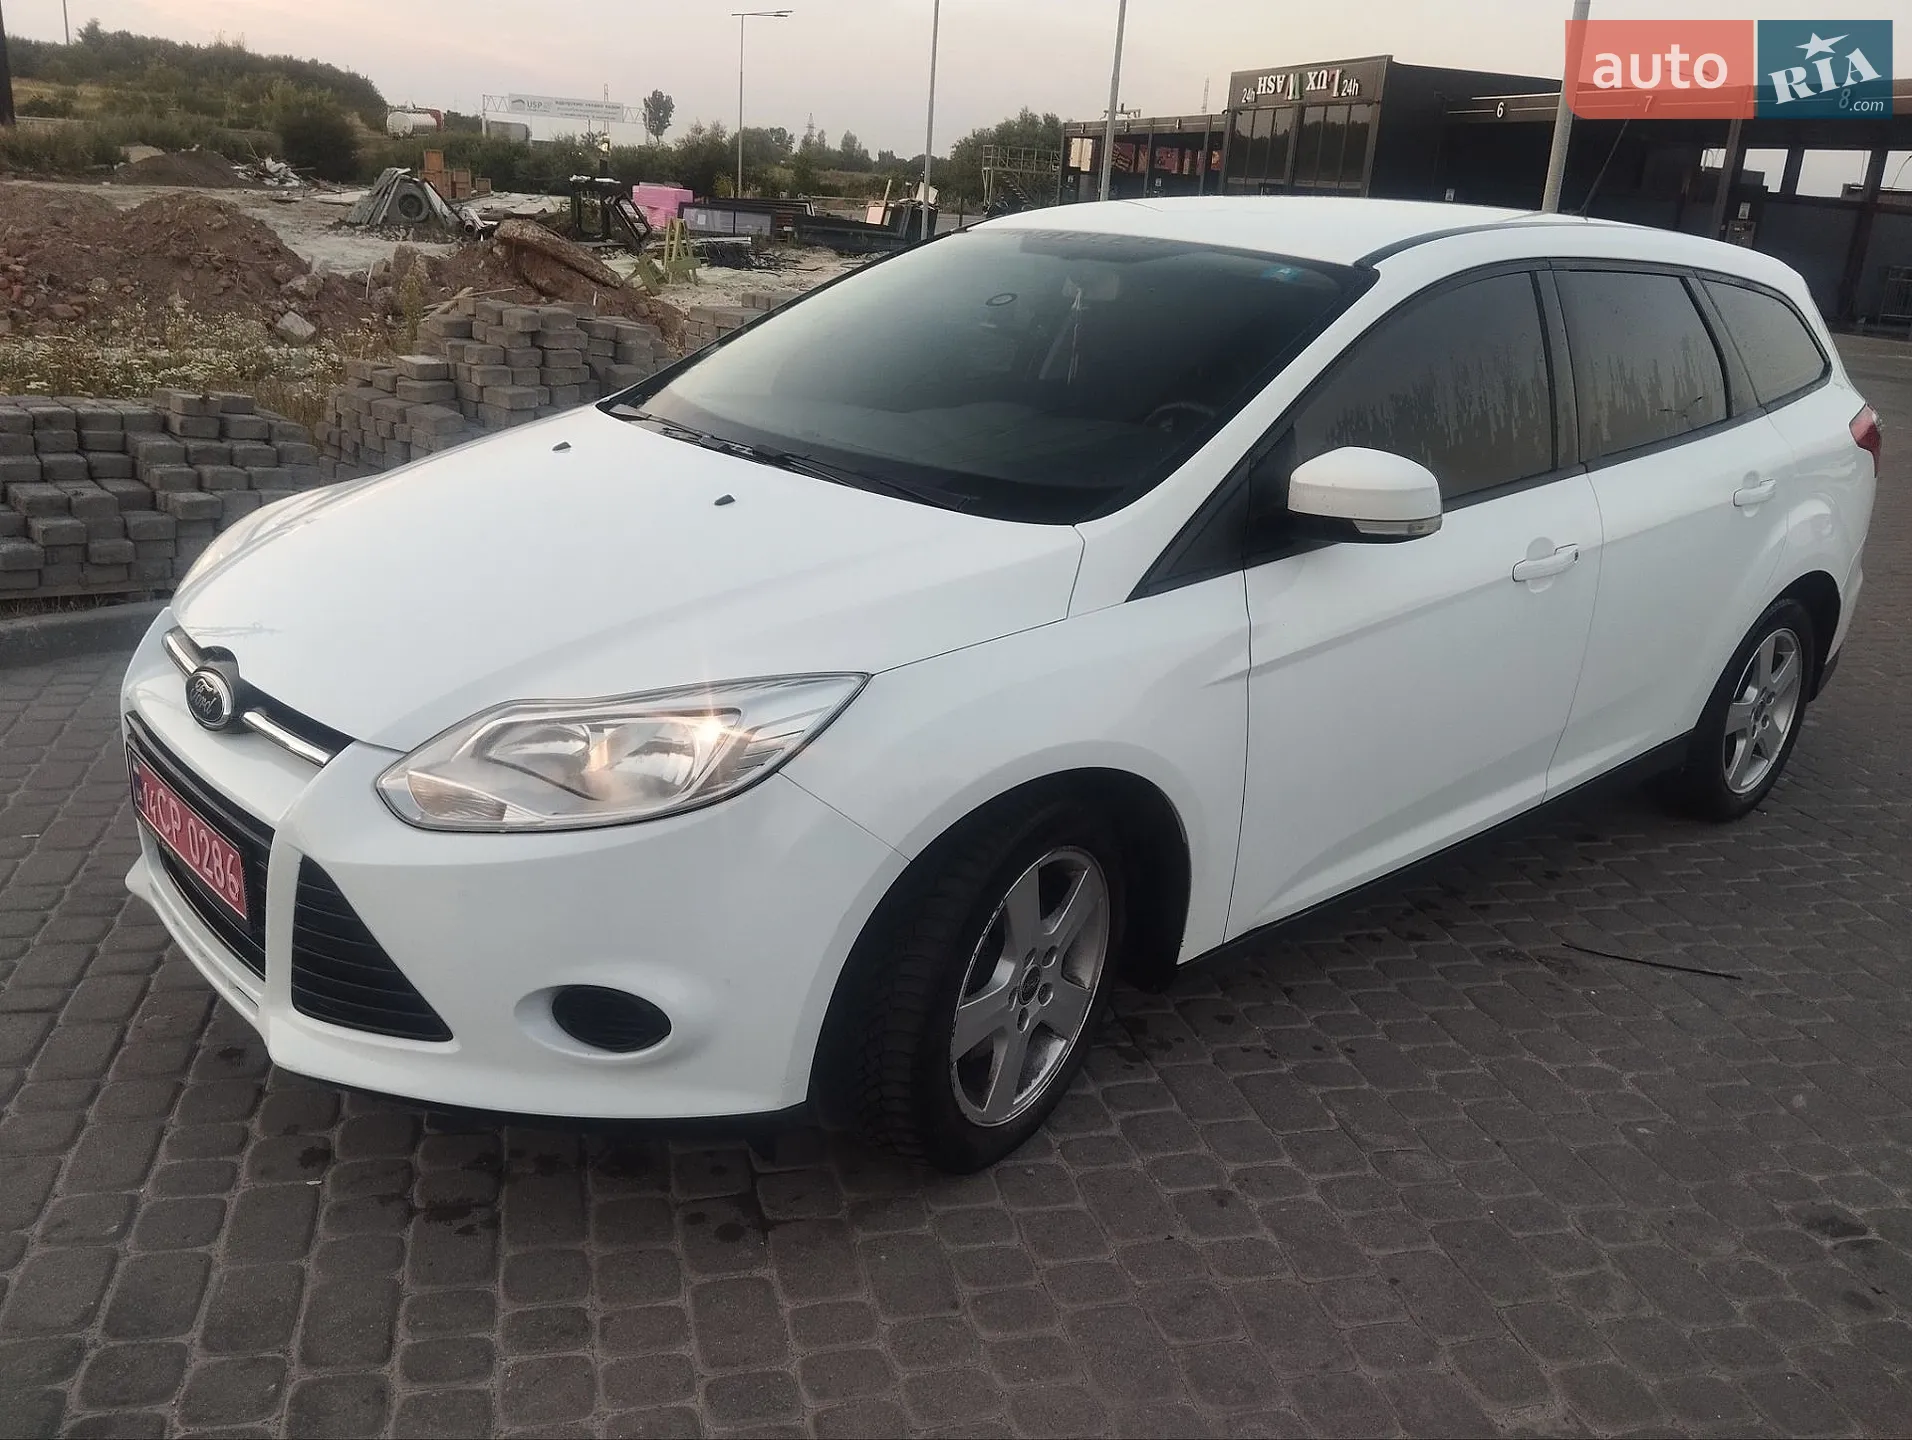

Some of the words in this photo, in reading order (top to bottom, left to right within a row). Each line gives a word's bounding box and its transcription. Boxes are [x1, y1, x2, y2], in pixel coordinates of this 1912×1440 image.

[1242, 88, 1256, 103] 24h
[1341, 78, 1359, 97] 24h
[527, 100, 543, 109] USP
[1643, 95, 1653, 112] 7
[1839, 88, 1850, 108] 8
[1495, 101, 1504, 118] 6
[190, 678, 217, 715] Ford
[188, 818, 239, 901] 0286
